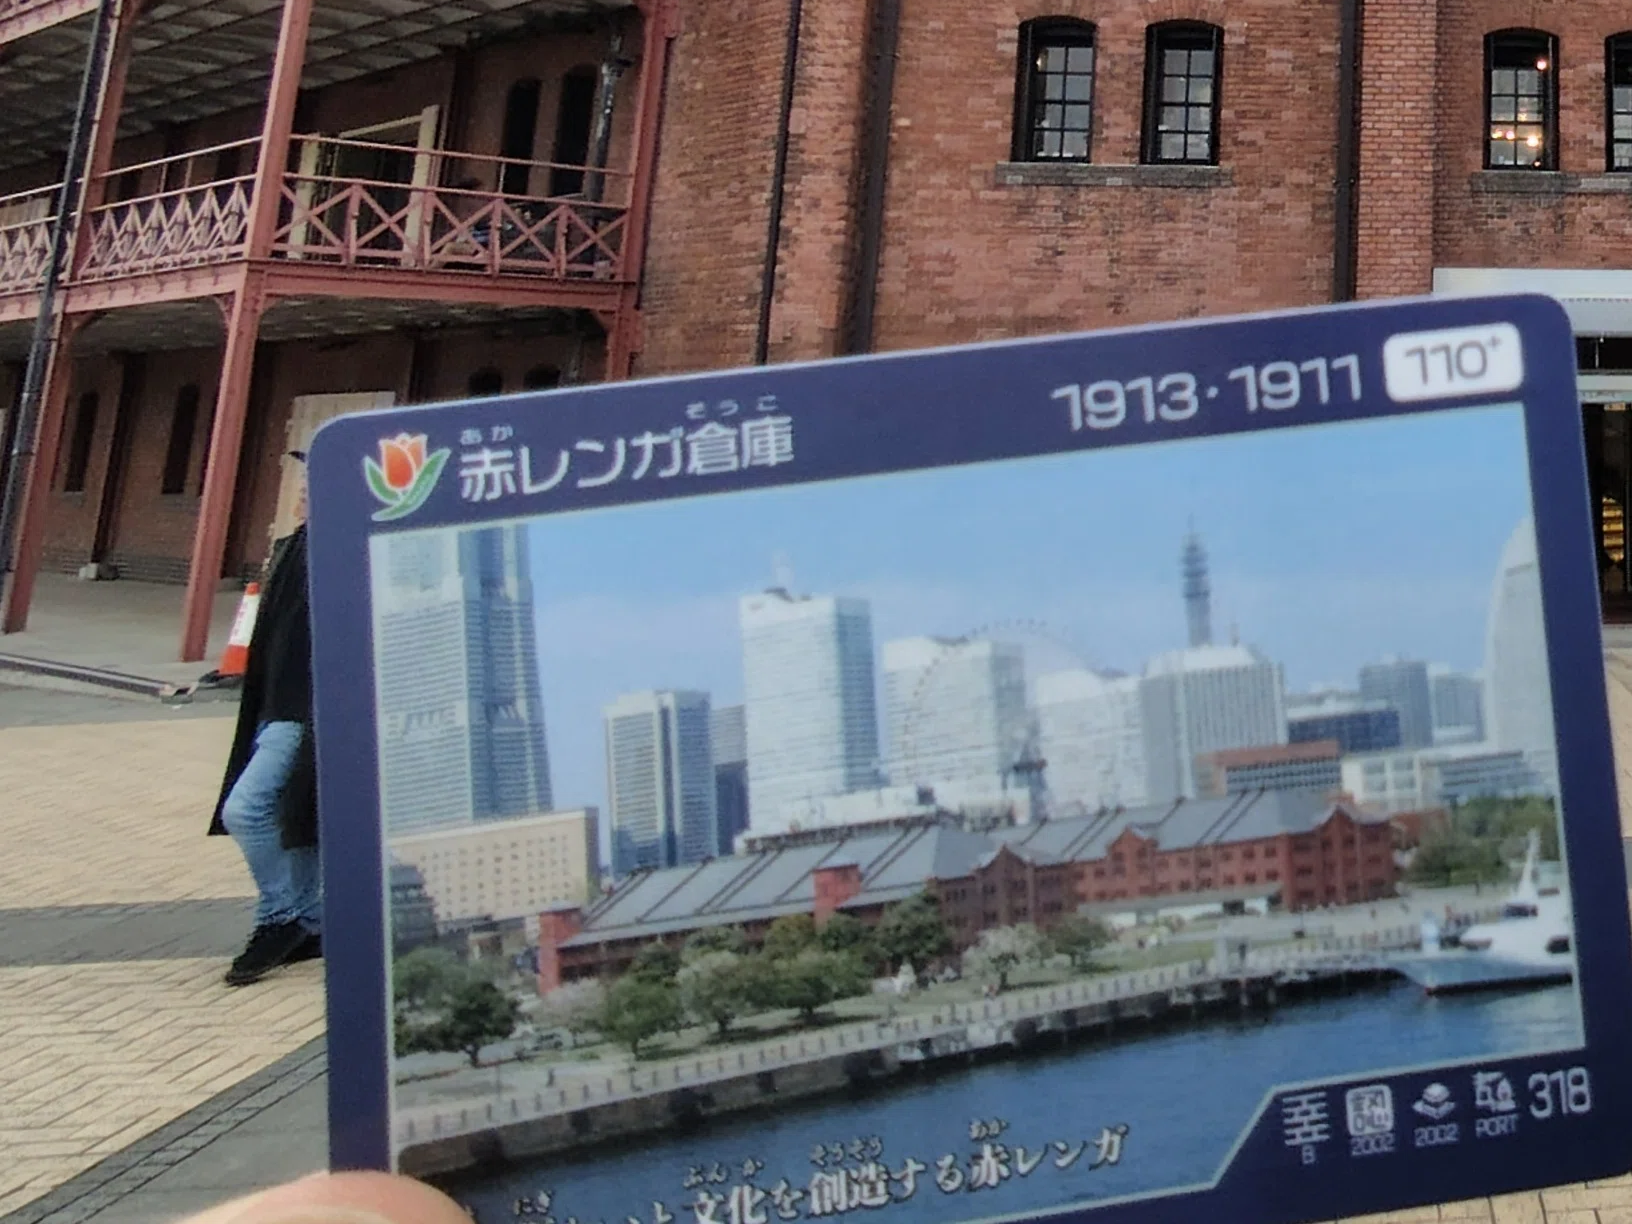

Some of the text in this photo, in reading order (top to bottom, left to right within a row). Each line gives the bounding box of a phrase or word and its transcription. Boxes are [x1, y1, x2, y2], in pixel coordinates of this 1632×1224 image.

[459, 415, 795, 503] 赤レンガ倉庫
[1528, 1066, 1592, 1119] 318
[1413, 1123, 1460, 1147] 2002
[1476, 1114, 1519, 1138] PORT
[1350, 1132, 1396, 1156] 2002
